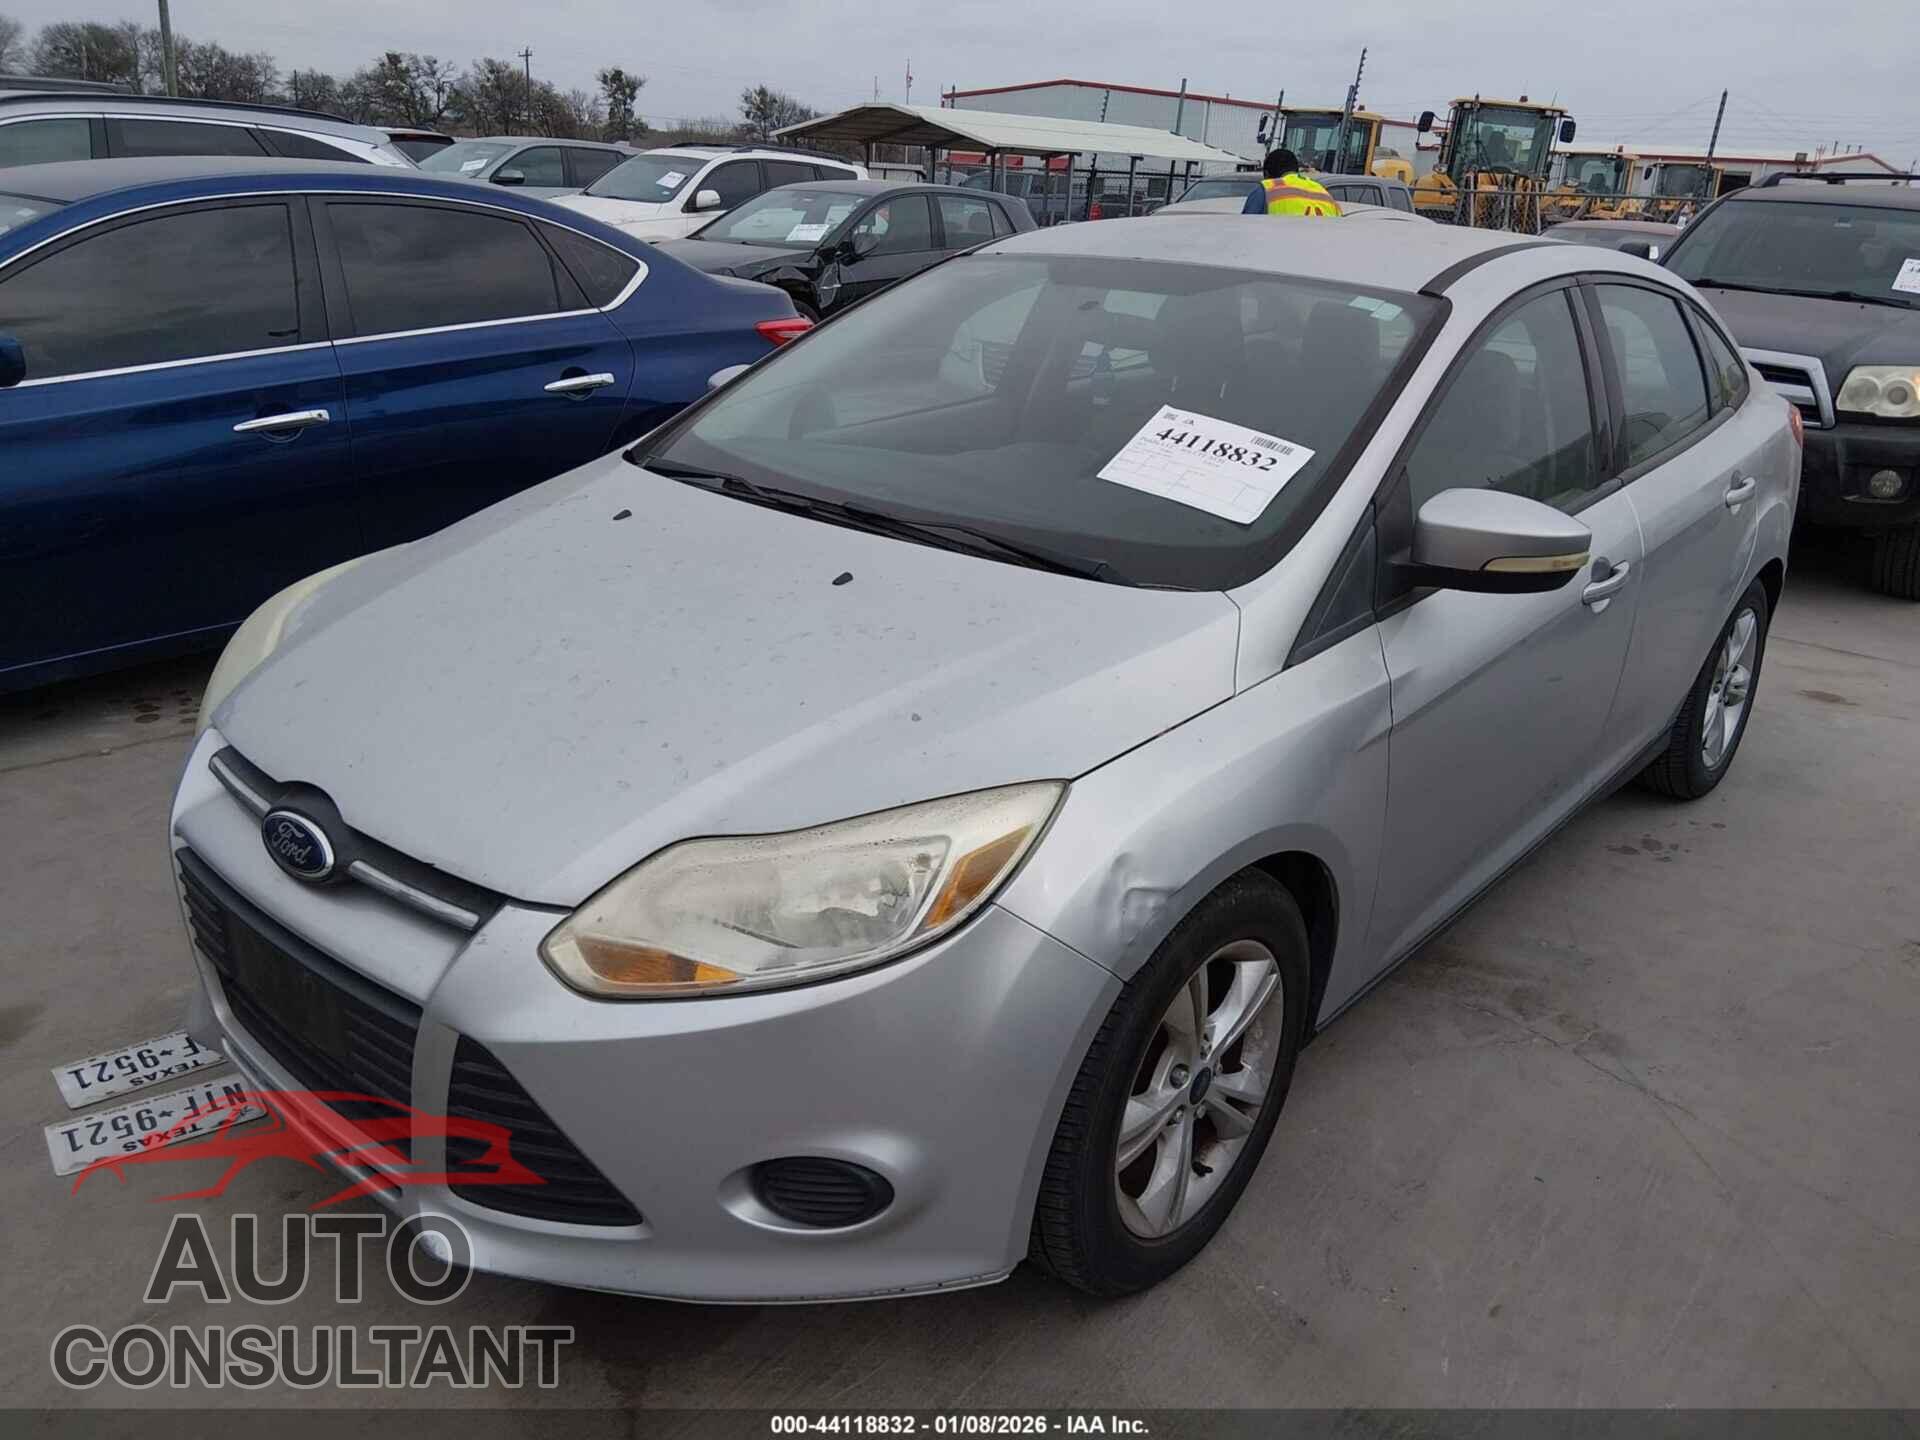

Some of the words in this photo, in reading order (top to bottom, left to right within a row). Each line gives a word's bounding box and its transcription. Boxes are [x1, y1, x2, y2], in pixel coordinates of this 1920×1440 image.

[1156, 428, 1278, 471] 44118832
[272, 822, 312, 864] Ford
[68, 1048, 160, 1089] 9521
[129, 1059, 205, 1087] TEXAS
[183, 1082, 247, 1120] NTF
[61, 1108, 158, 1152] 9521
[122, 1125, 203, 1152] TEXAS
